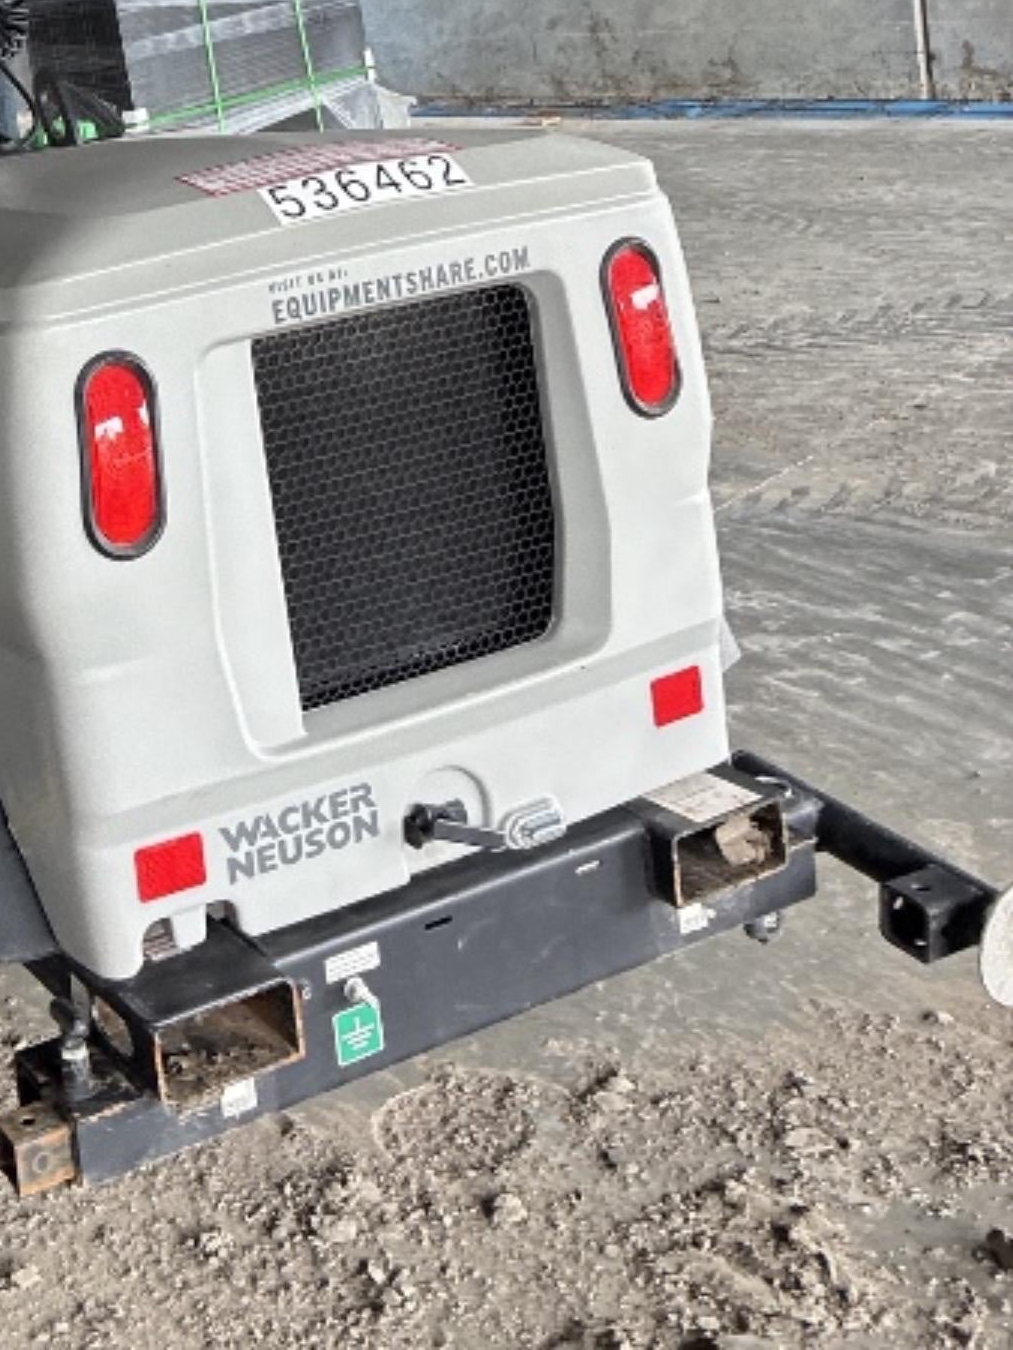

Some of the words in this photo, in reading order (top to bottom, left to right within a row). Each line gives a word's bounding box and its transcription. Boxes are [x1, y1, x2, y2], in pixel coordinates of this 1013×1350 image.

[268, 155, 466, 219] 536462
[272, 247, 530, 324] EQUIPMENTSHARE.COM
[218, 782, 377, 852] WACKER
[226, 809, 380, 885] NEUSON
